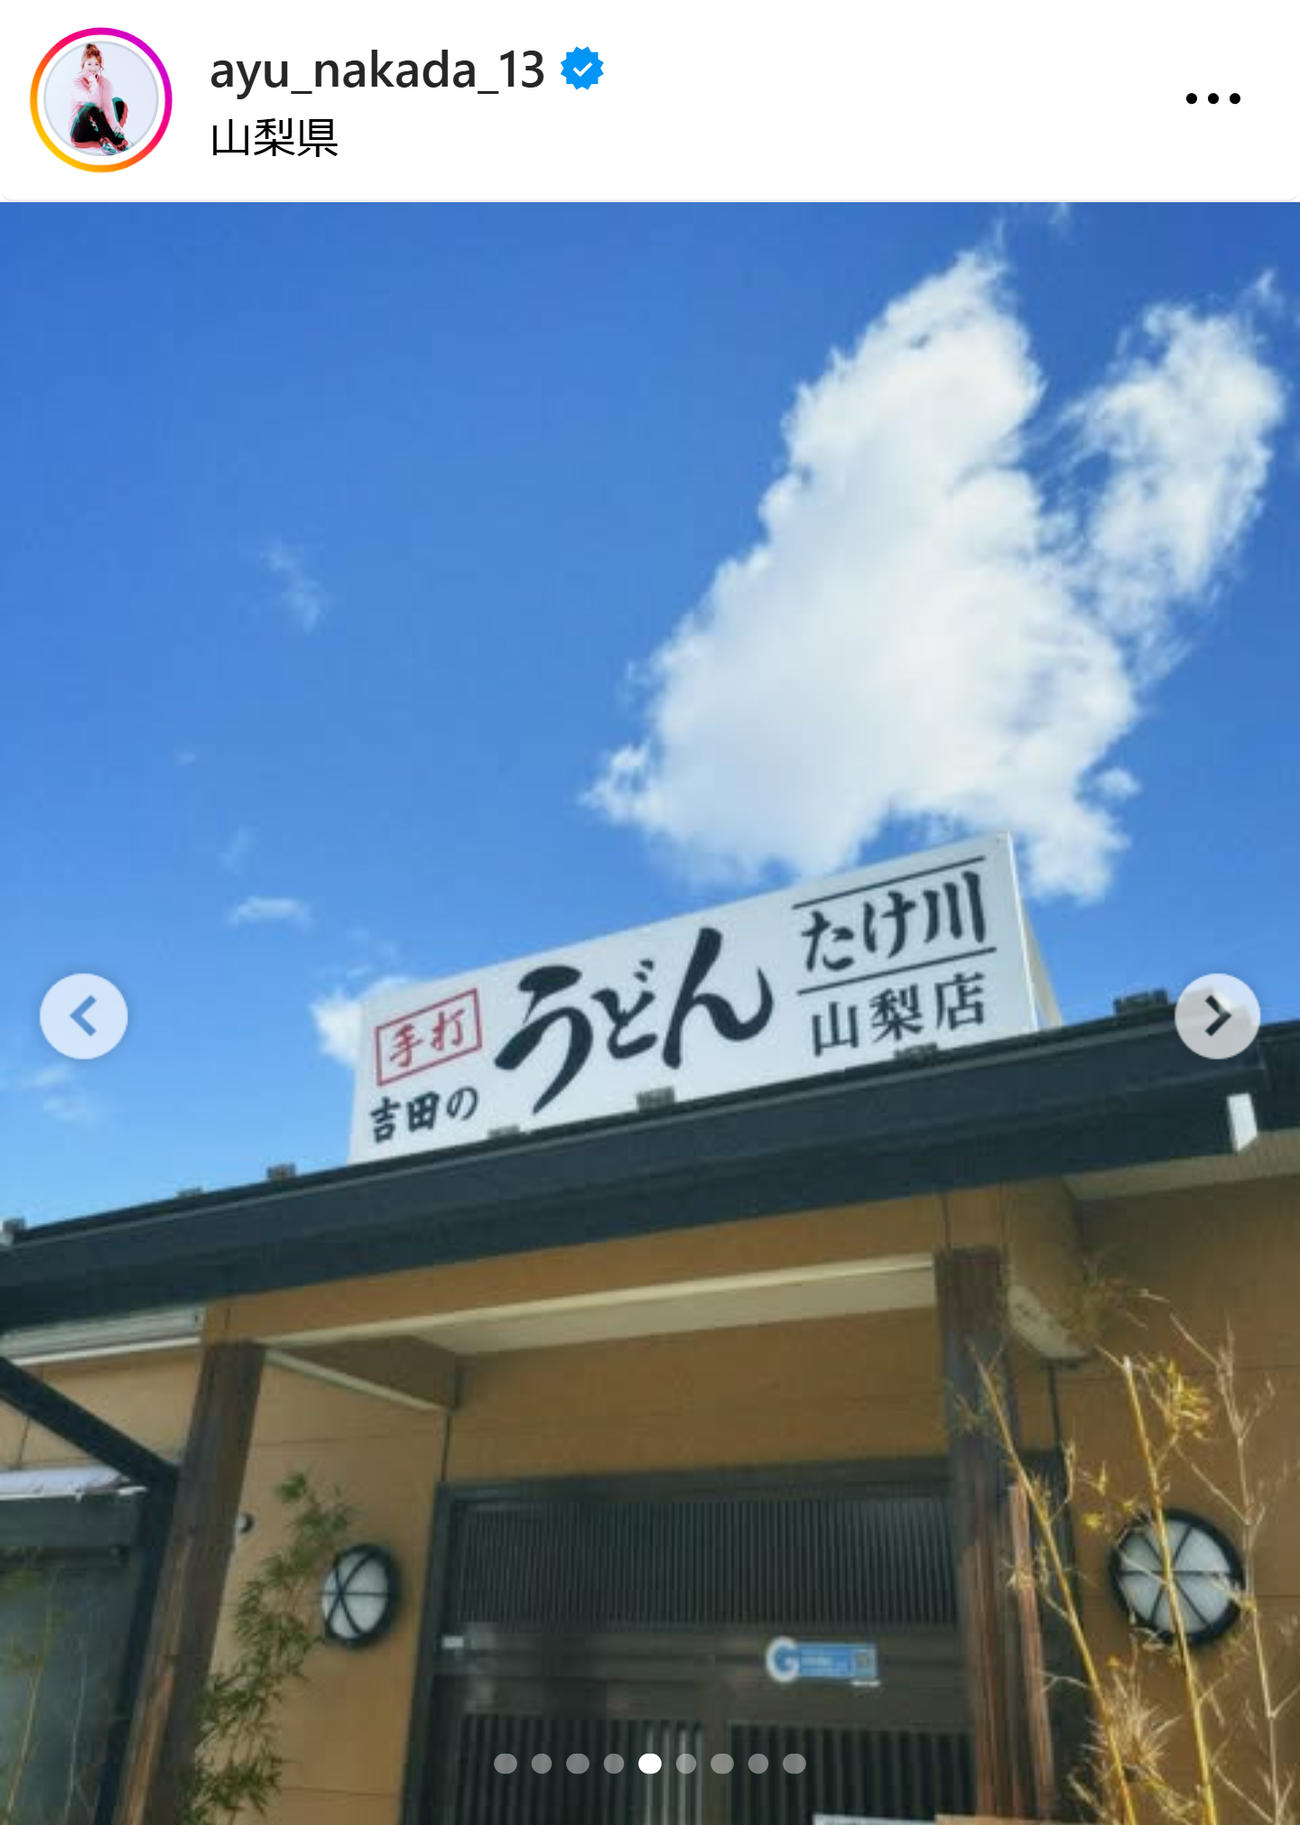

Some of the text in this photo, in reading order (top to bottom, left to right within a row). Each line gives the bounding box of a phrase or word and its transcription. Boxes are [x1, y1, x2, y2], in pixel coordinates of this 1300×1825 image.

[803, 870, 986, 973] たけ川
[389, 1001, 467, 1068] 手打
[494, 927, 774, 1115] うどん
[811, 972, 986, 1057] 山梨店
[370, 1085, 480, 1144] 吉田の
[765, 1636, 800, 1683] G
